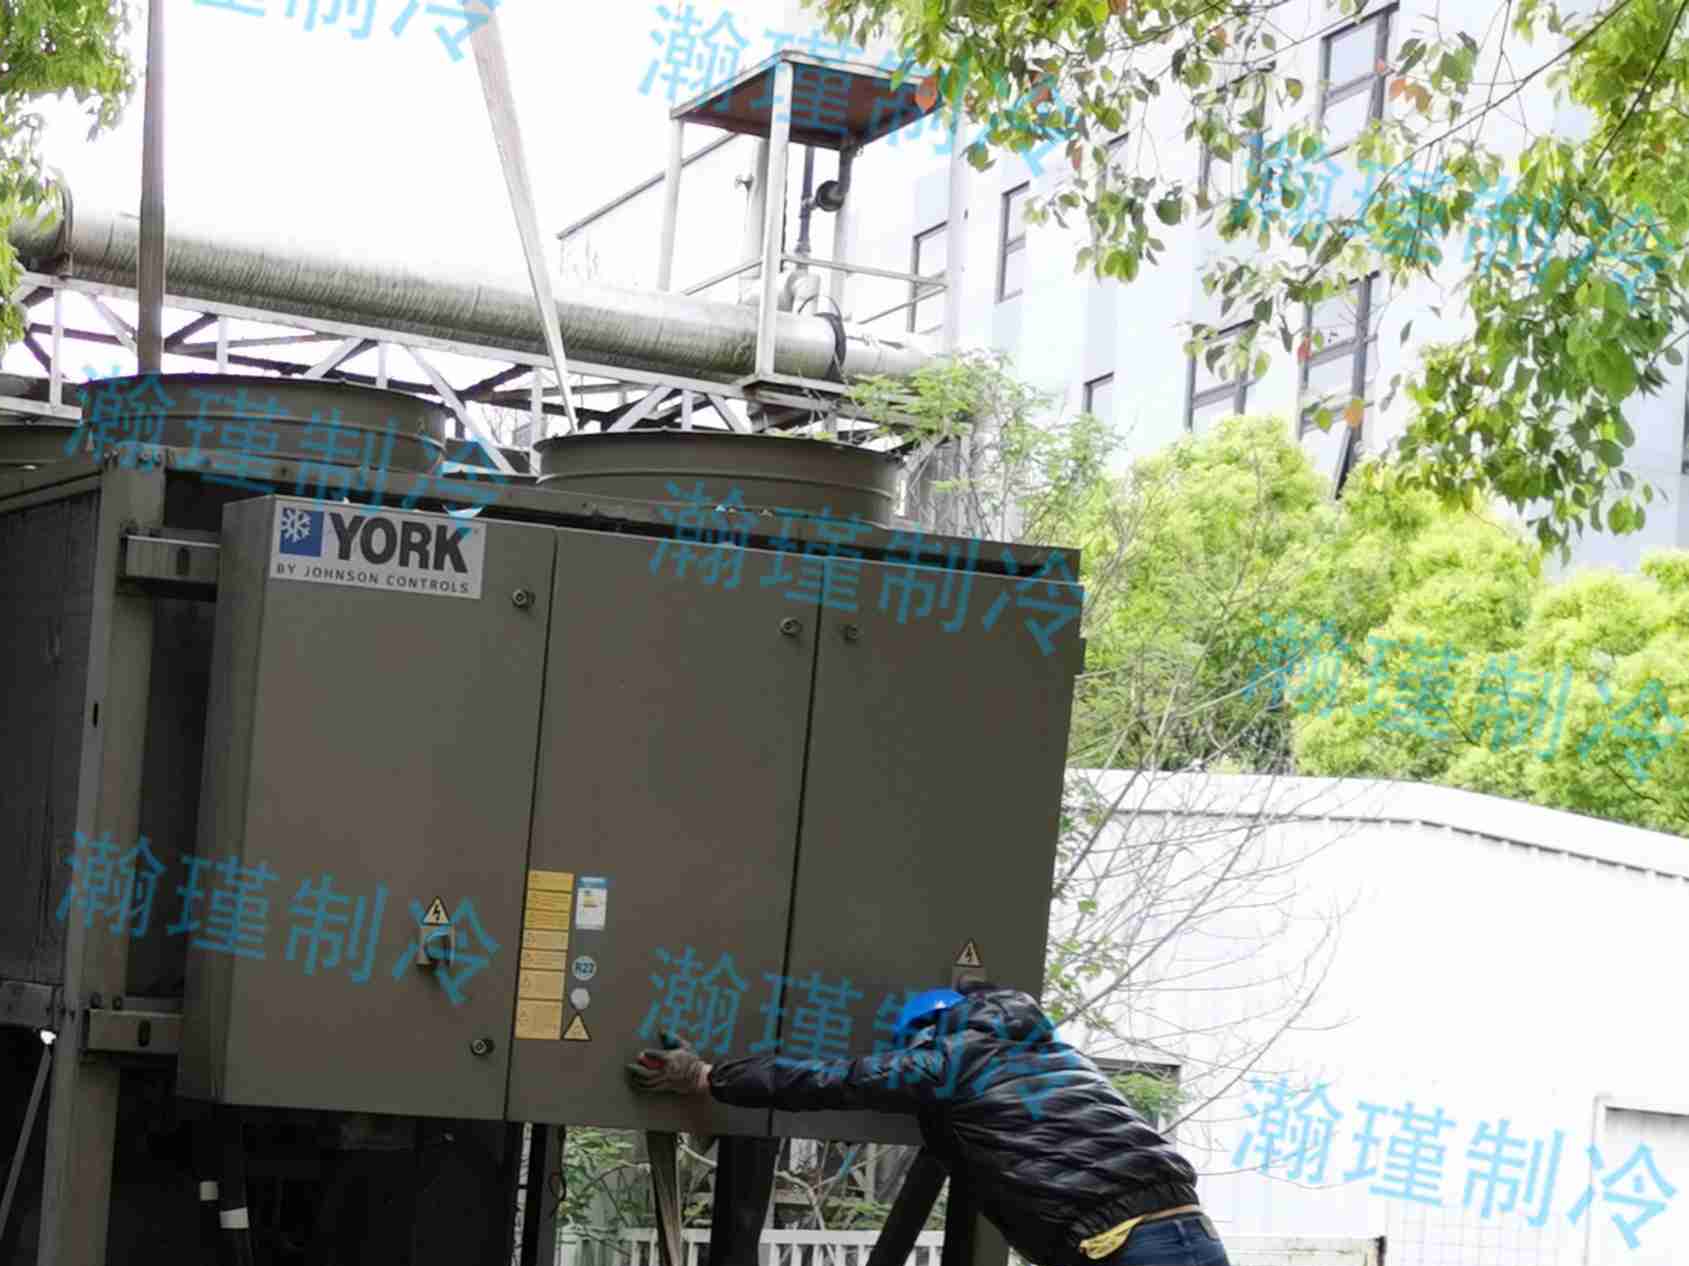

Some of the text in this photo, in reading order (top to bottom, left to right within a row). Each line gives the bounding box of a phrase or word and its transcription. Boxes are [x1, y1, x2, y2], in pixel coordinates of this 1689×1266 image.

[328, 512, 469, 573] YORK
[276, 563, 470, 594] BY JOHNSON CONTROLS
